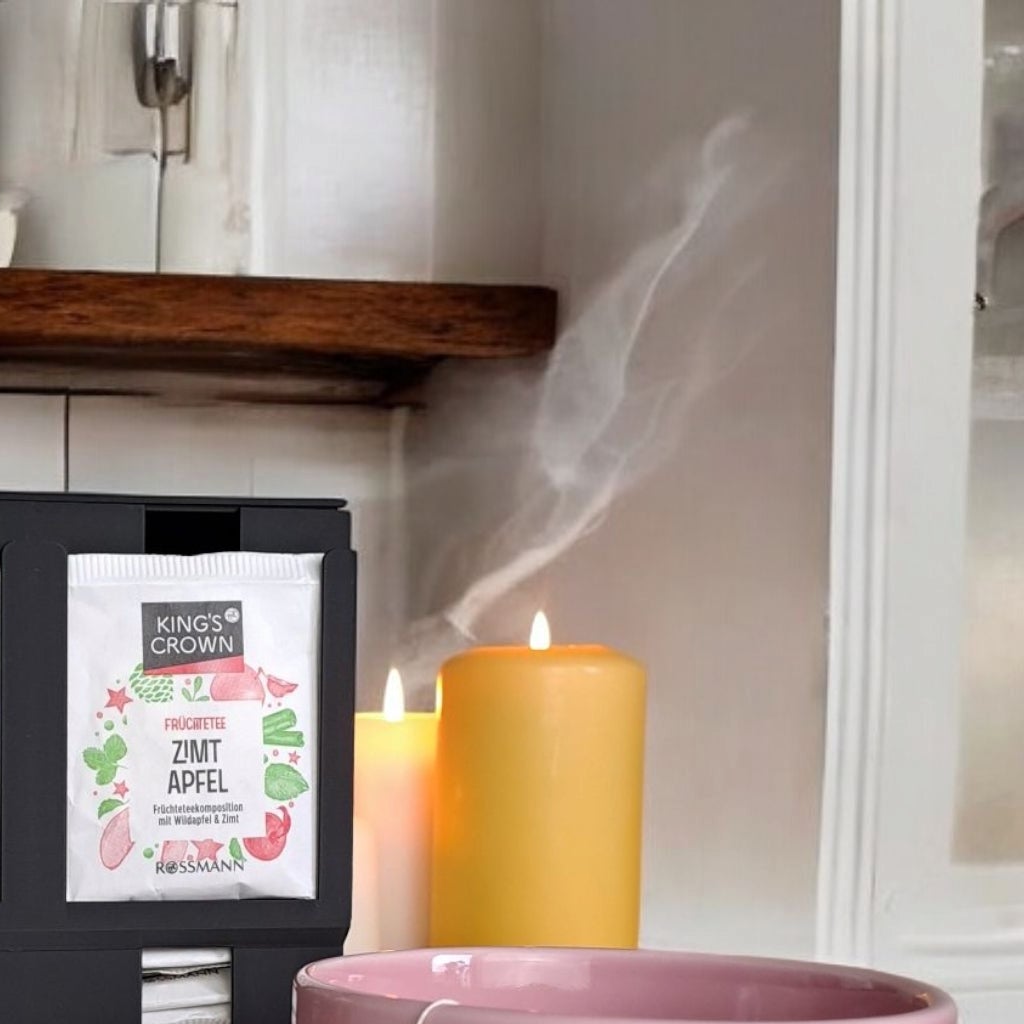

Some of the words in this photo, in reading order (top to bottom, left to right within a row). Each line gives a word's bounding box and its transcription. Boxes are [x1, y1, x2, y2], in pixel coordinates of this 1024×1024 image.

[157, 613, 223, 633] KING'S
[151, 635, 233, 655] CROWN
[164, 716, 227, 731] FRÜCHTETEE
[172, 739, 222, 764] ZIMT
[167, 769, 229, 795] APFEL
[153, 802, 243, 814] Früchteteekomposition
[158, 815, 172, 826] mit
[174, 814, 212, 826] Wildapfel
[214, 814, 220, 824] &
[221, 813, 239, 824] Zimt
[156, 860, 244, 874] ROSSMANN
